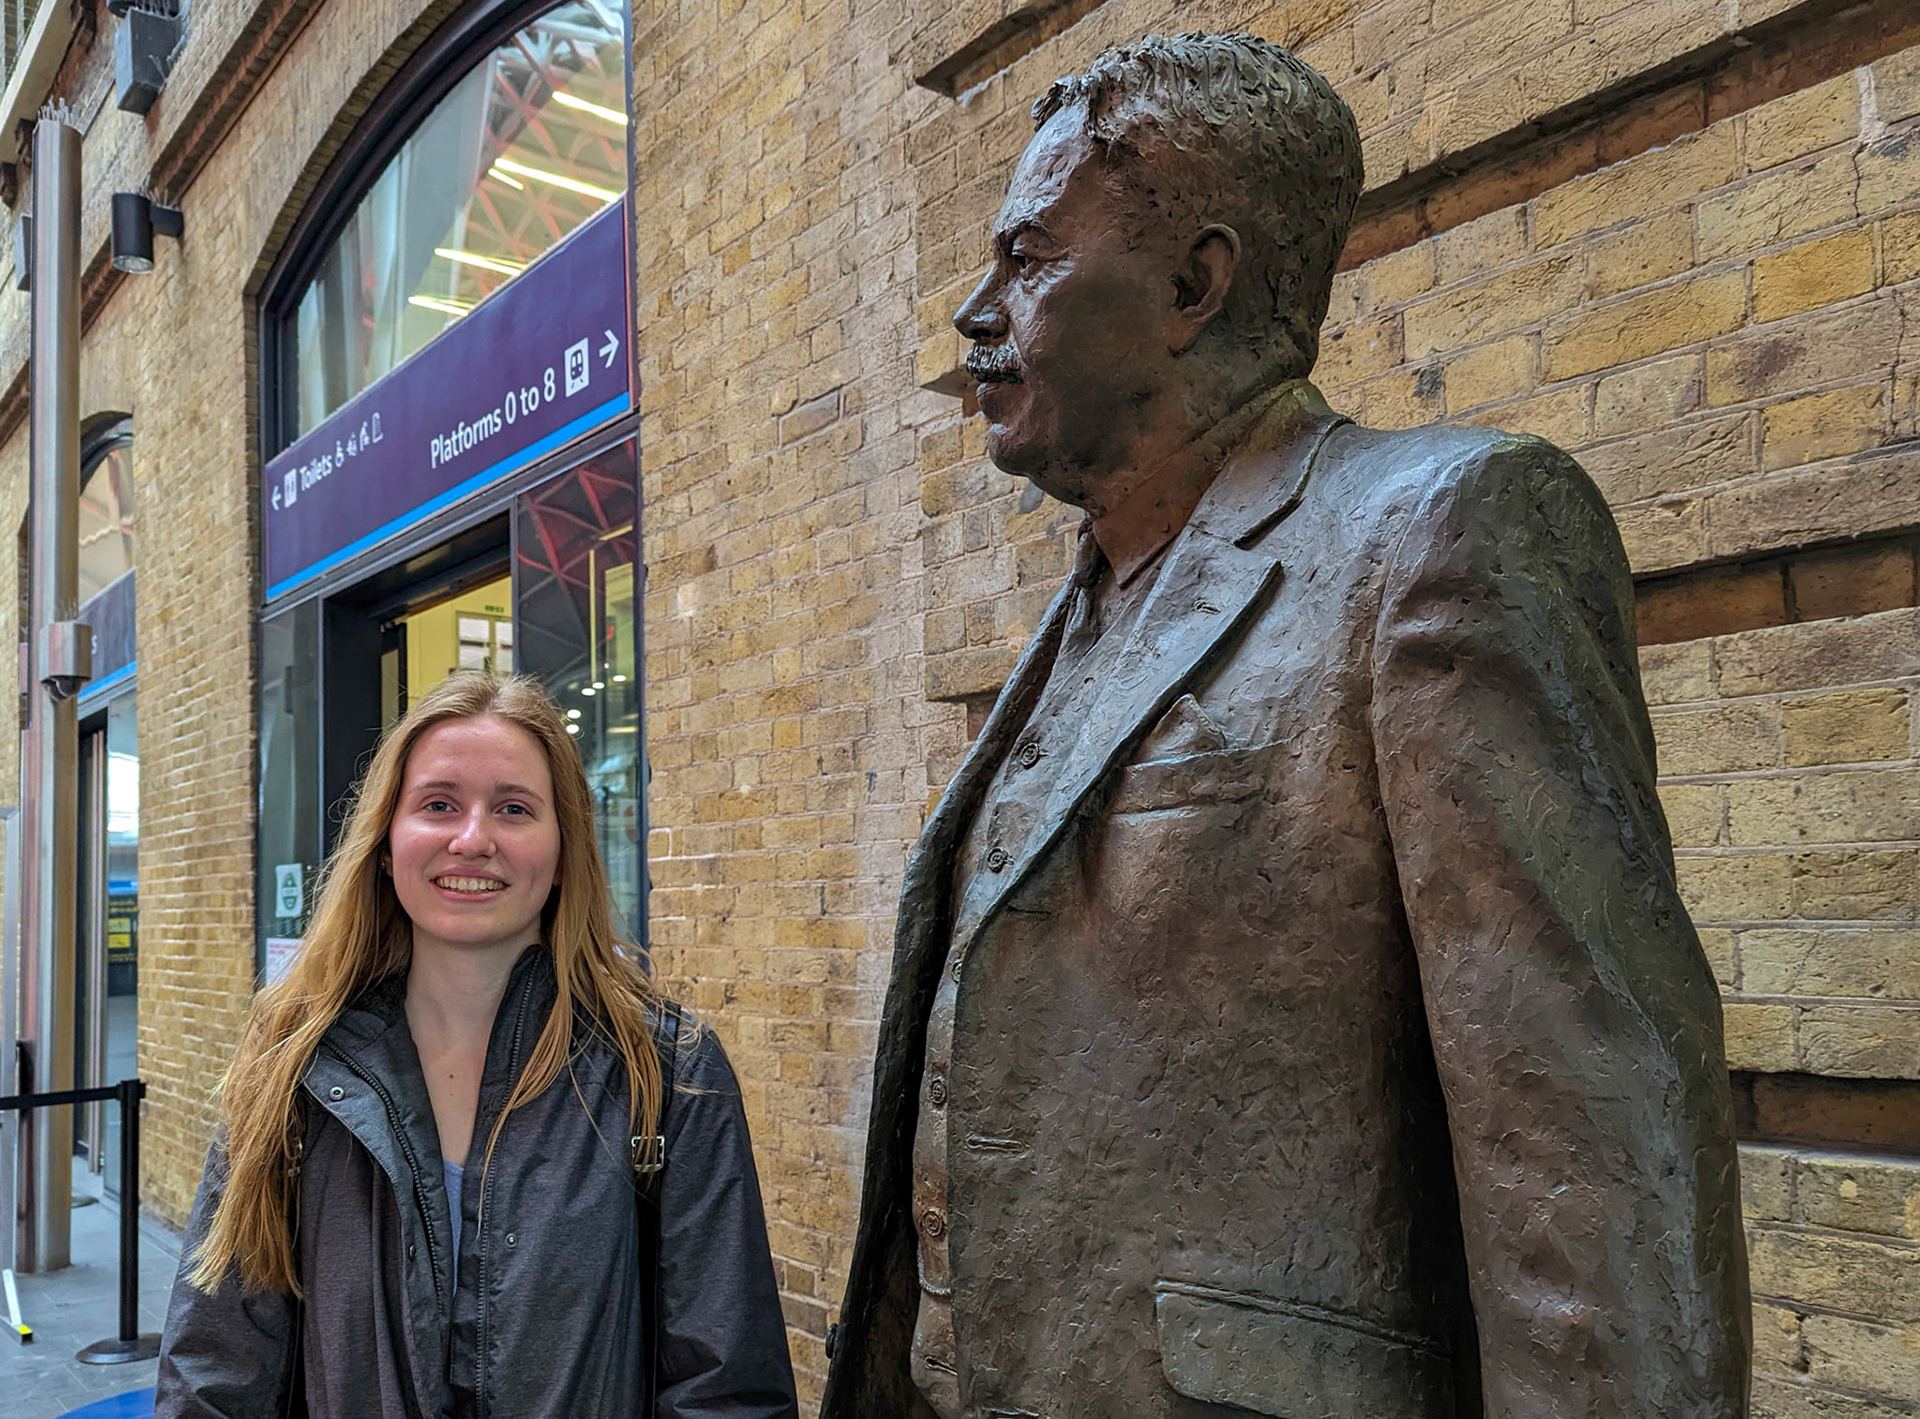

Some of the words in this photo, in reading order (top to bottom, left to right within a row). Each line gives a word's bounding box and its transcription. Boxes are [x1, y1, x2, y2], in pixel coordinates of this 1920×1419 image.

[430, 408, 502, 469] Platforms
[505, 391, 517, 425] 0
[519, 386, 540, 416] to
[543, 367, 556, 402] 8
[299, 454, 333, 491] Toilets
